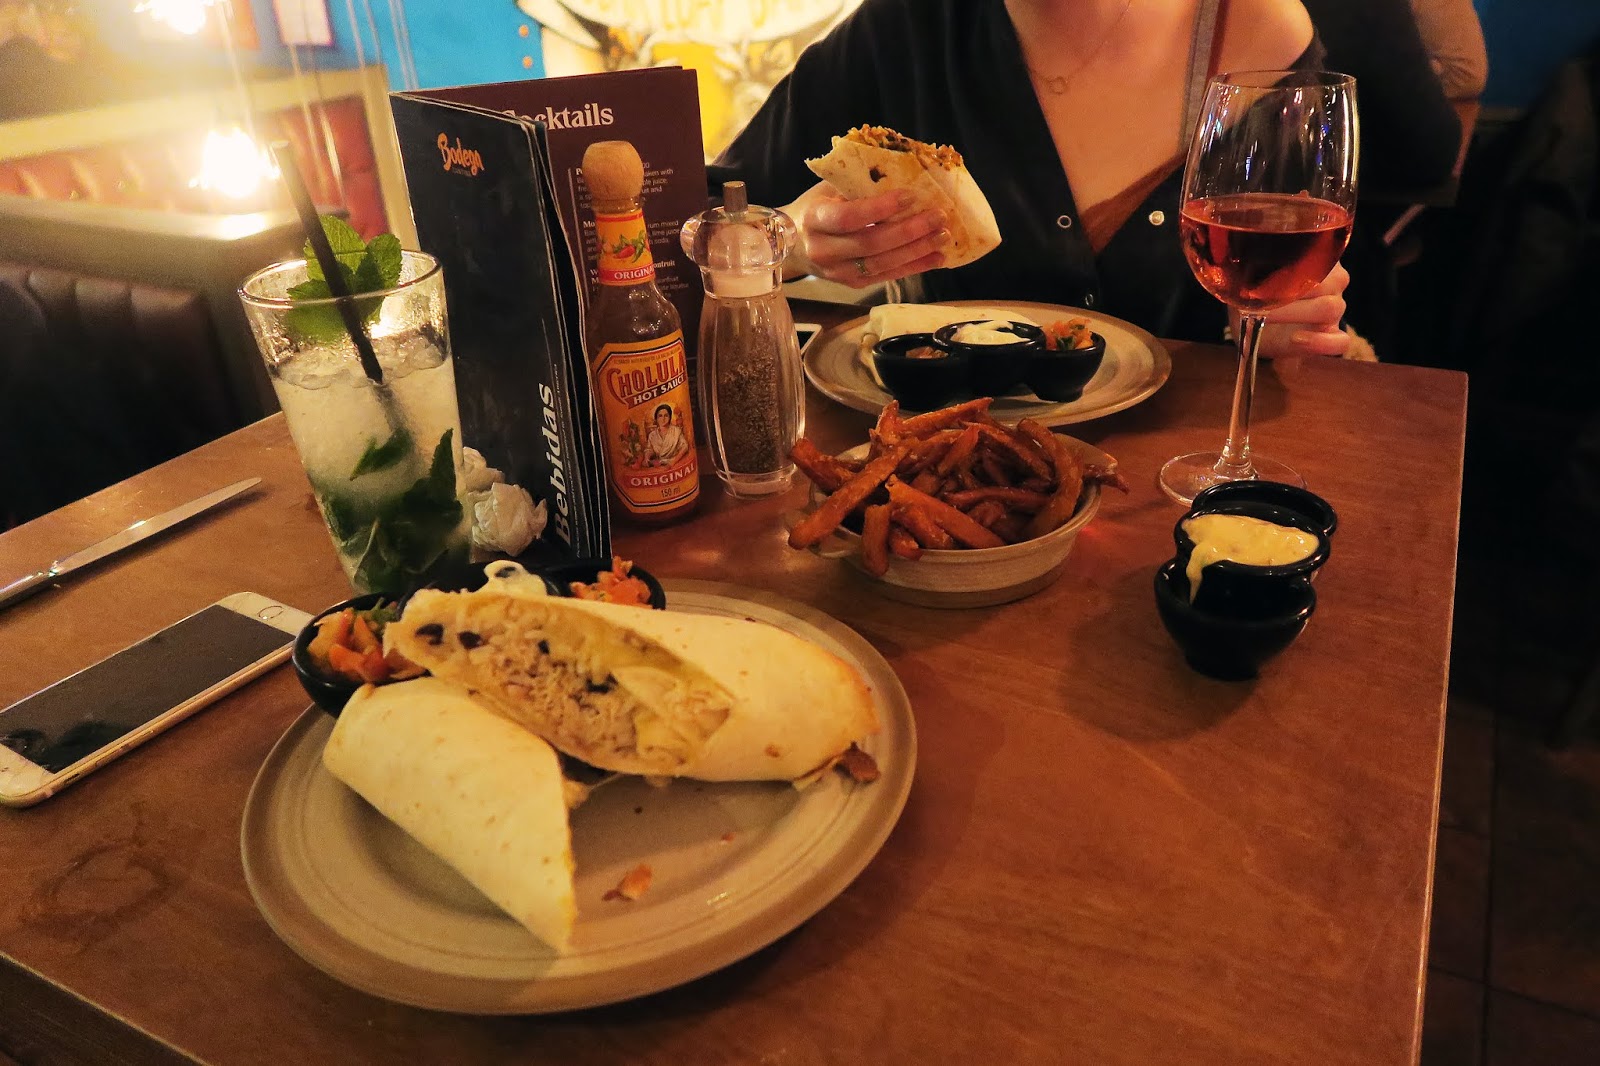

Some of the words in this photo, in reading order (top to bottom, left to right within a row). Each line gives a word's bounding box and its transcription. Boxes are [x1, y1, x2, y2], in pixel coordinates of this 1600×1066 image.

[502, 102, 614, 130] cktails
[614, 265, 656, 280] ORIGINA
[633, 388, 658, 405] HOT
[538, 382, 572, 547] Bebidas
[630, 462, 695, 487] ORIGINAL
